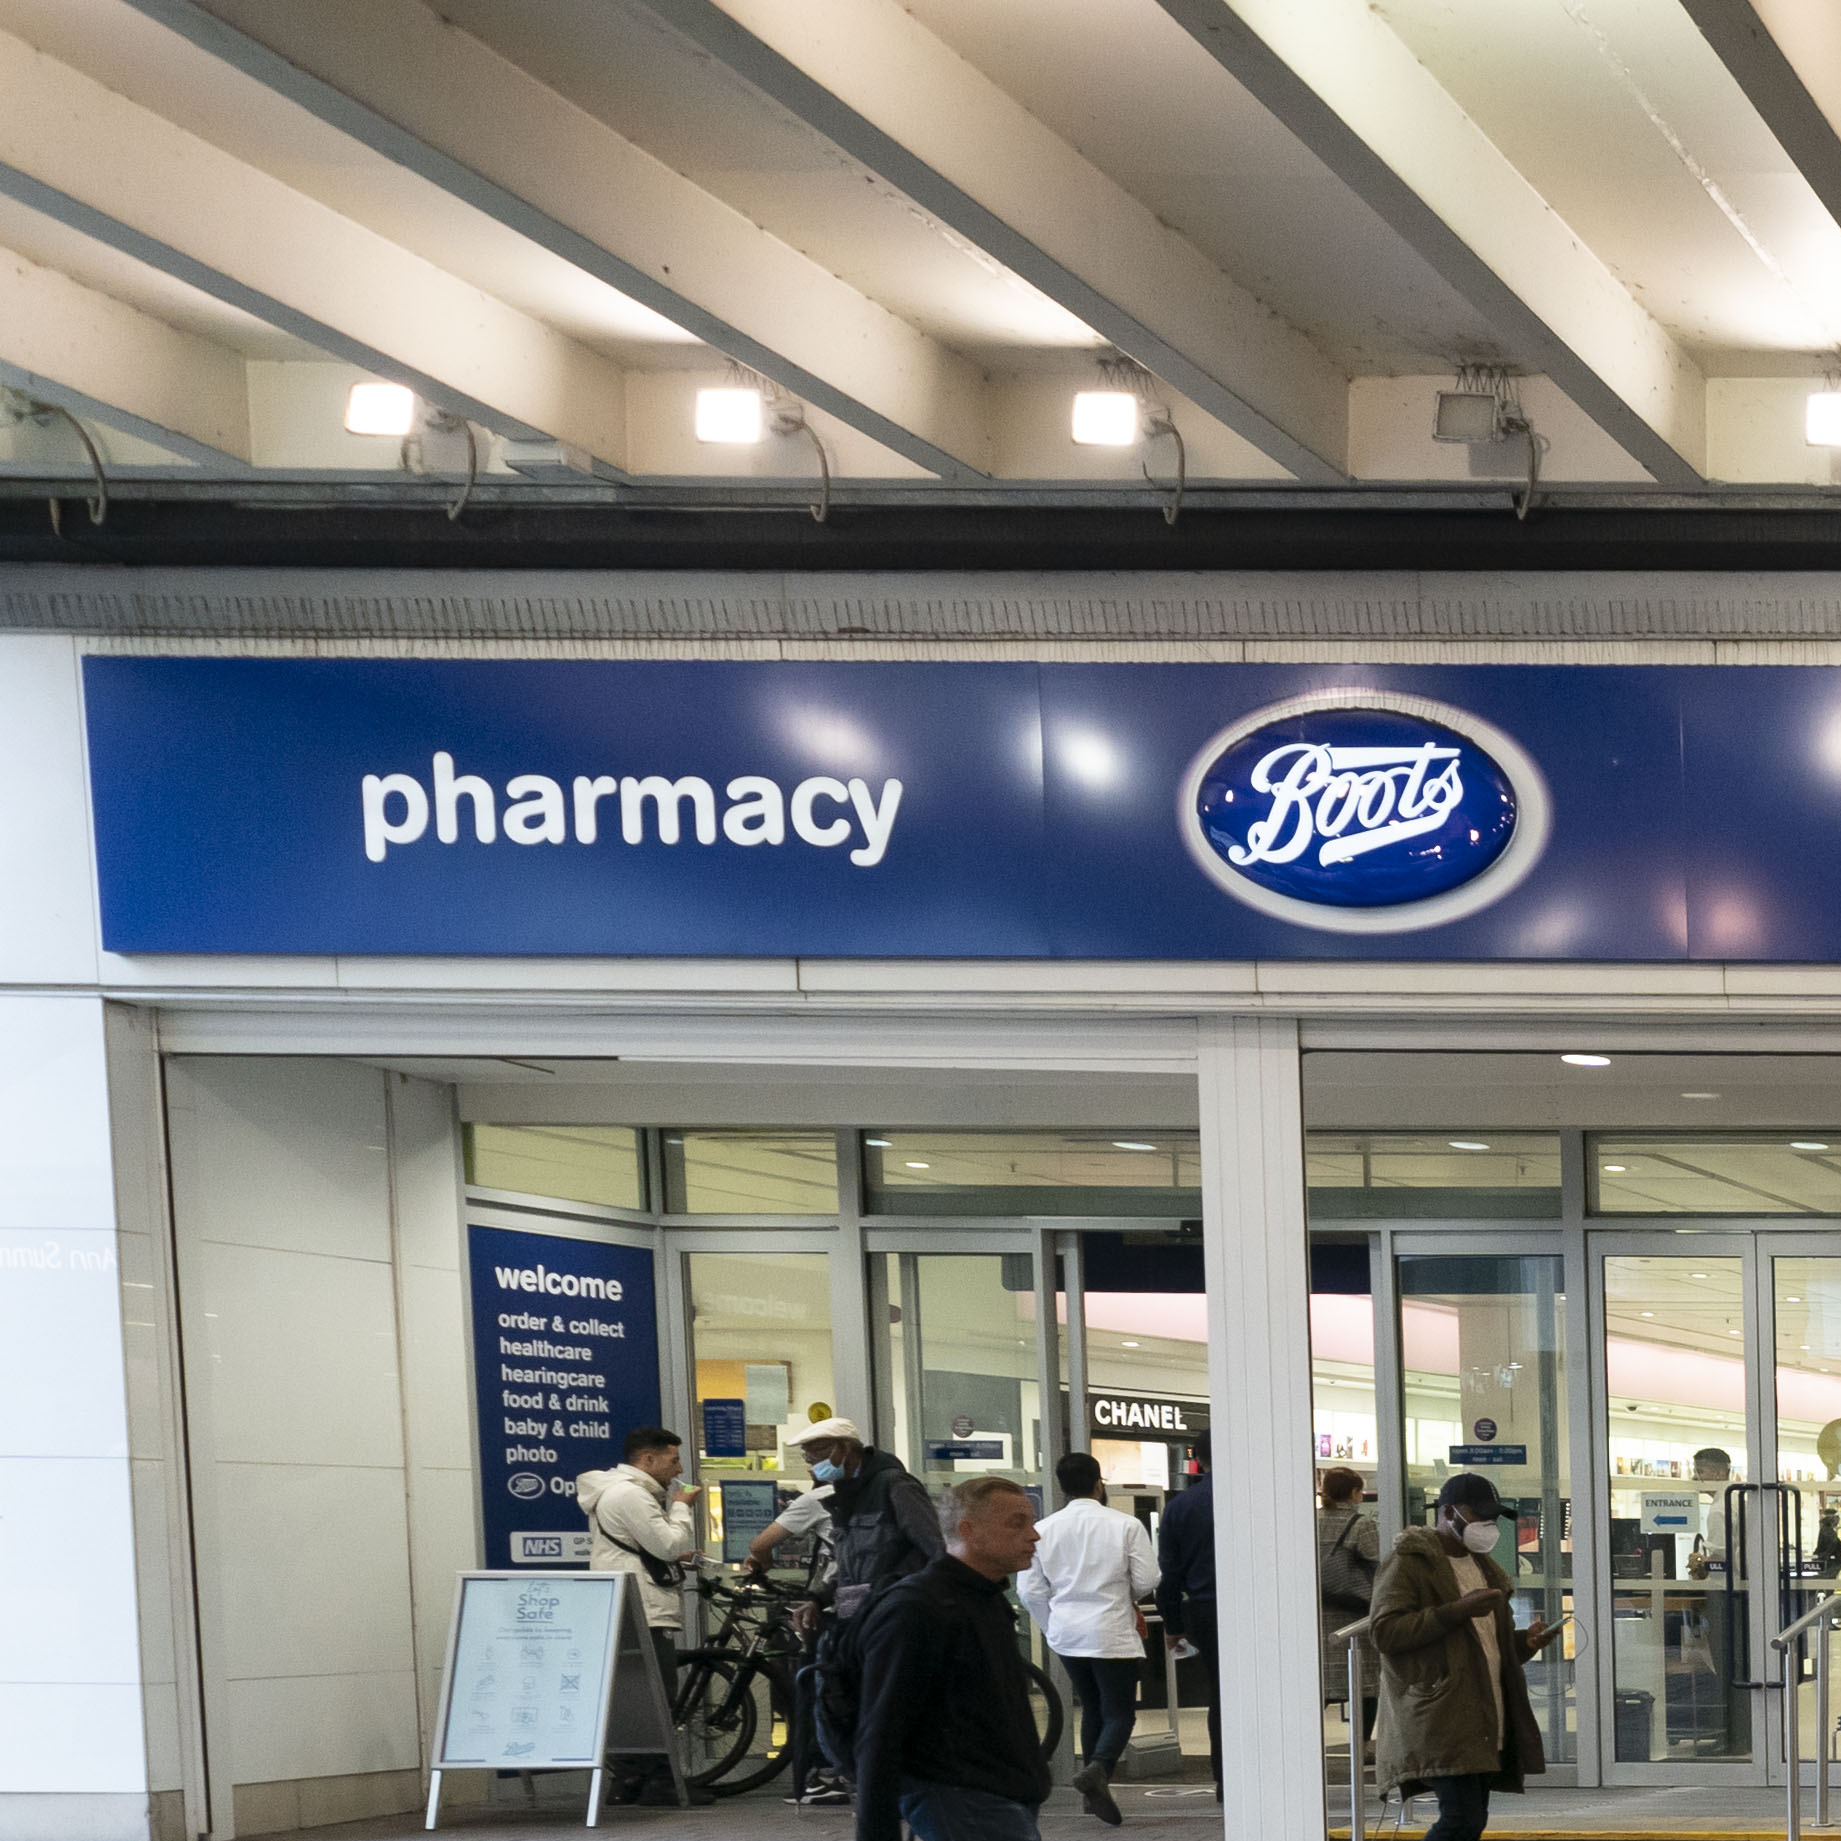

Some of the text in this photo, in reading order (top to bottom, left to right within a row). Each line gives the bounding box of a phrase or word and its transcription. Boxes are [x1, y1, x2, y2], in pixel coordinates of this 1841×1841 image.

[362, 751, 903, 866] pharmacy
[1228, 742, 1463, 867] Boots
[494, 1264, 623, 1301] welcome
[498, 1312, 625, 1338] order & collect
[499, 1336, 592, 1361] healthcare
[501, 1363, 605, 1389] hearingcare
[502, 1390, 609, 1413] food & drink
[1094, 1400, 1188, 1430] CHANEL
[504, 1417, 610, 1439] baby & child
[506, 1444, 558, 1464] photo
[1645, 1499, 1693, 1508] ENTRANCE
[524, 1538, 561, 1555] NHS
[517, 1607, 554, 1620] Safe
[518, 1594, 560, 1609] Shop
